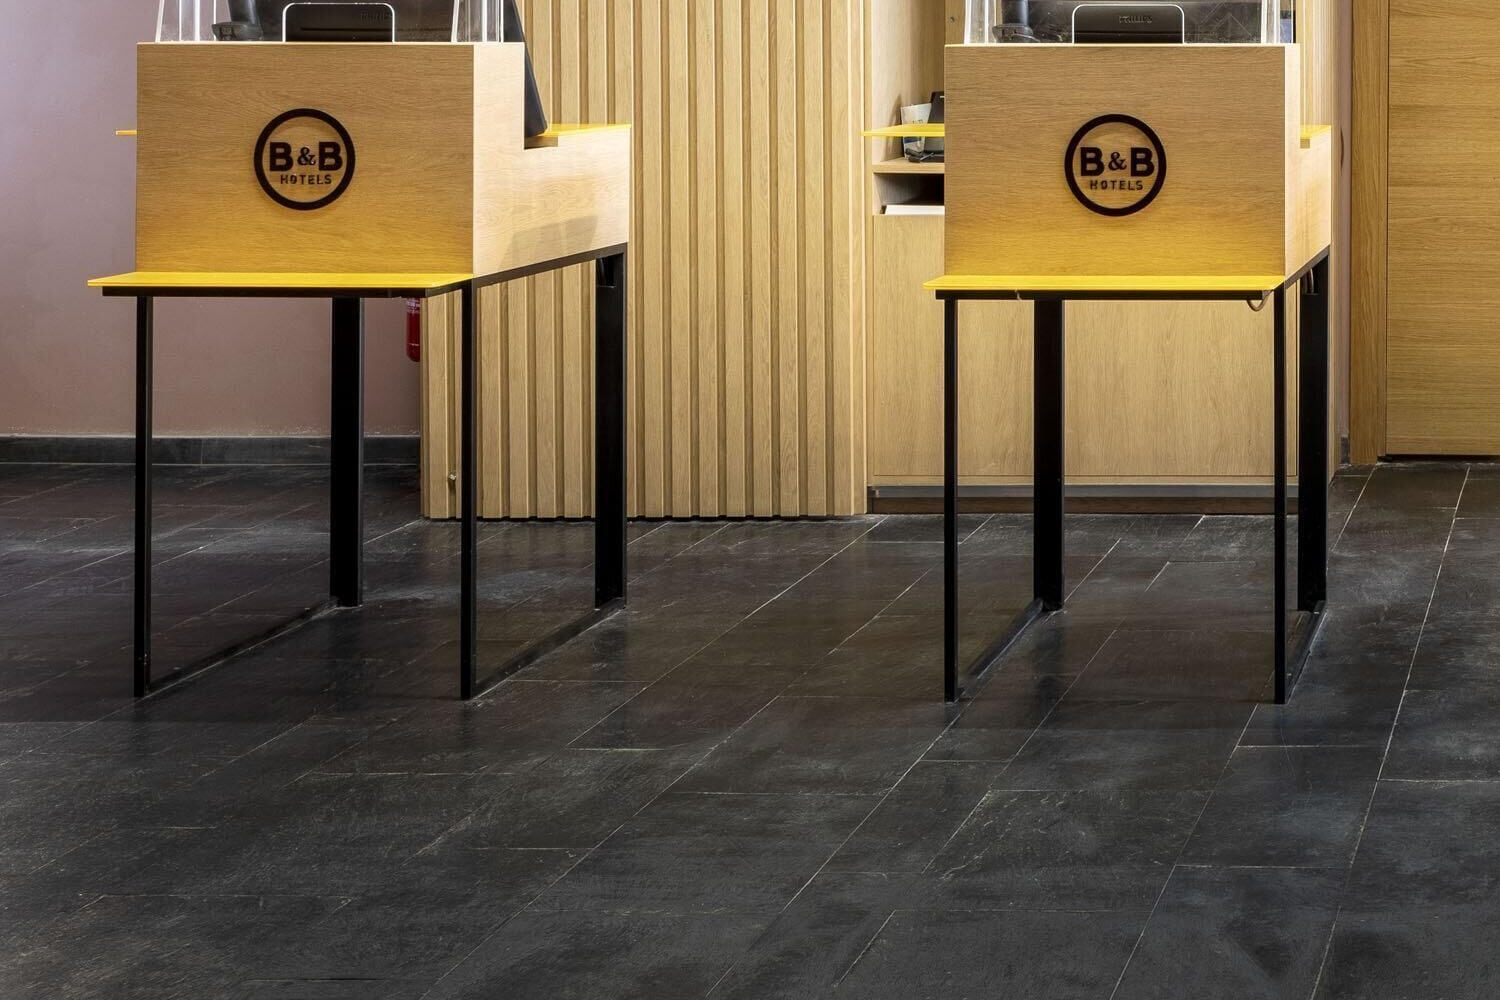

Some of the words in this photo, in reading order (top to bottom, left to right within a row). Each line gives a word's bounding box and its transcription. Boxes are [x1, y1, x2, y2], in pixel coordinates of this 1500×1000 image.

[269, 141, 343, 172] B&B
[1080, 146, 1155, 177] B&B
[280, 174, 332, 186] HOTELS
[1089, 180, 1144, 191] HOTELS
